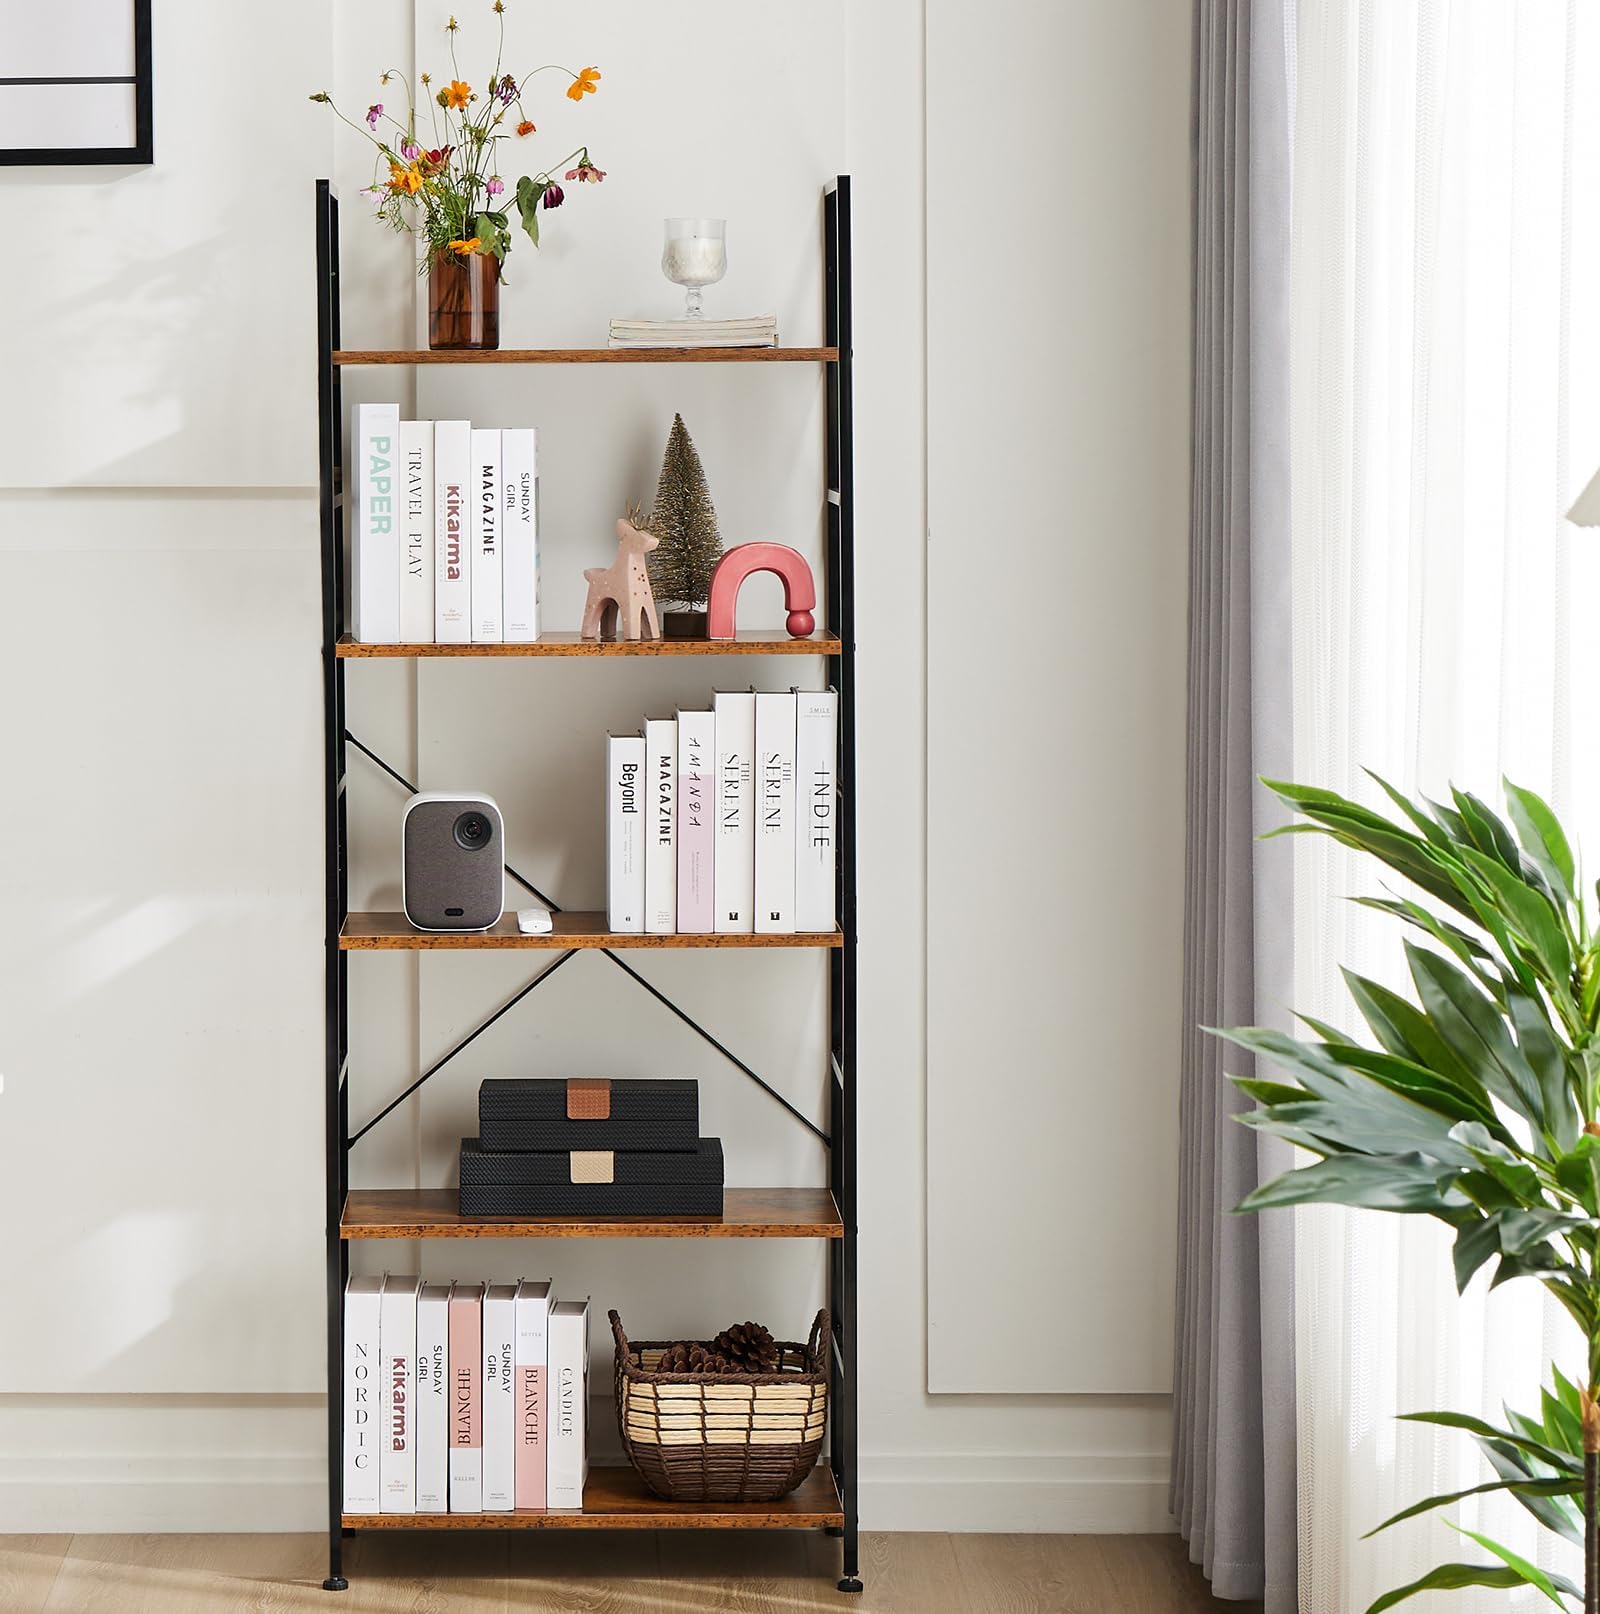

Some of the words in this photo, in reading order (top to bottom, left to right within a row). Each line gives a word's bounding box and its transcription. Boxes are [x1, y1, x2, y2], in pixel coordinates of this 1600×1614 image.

[369, 436, 391, 534] PAPER
[409, 447, 422, 520] TRAVEL
[482, 465, 495, 556] MAGAZINE
[506, 484, 516, 512] GIRL
[520, 472, 530, 523] SUNDAY
[409, 533, 422, 578] PLAY
[618, 763, 638, 814] Beyond
[659, 755, 672, 846] MAGAZINE
[688, 737, 701, 827] AMANDA
[725, 753, 740, 835] SERENE
[741, 760, 751, 784] THE
[766, 752, 782, 834] SERENE
[782, 760, 792, 784] THE
[813, 771, 830, 848] INDIE
[418, 1356, 428, 1384] GIRL
[433, 1344, 443, 1396] SUNDAY
[487, 1354, 497, 1382] GIRL
[501, 1343, 511, 1394] SUNDAY
[561, 1367, 573, 1437] CANDICE
[457, 1367, 471, 1445] BLANCHE
[524, 1368, 538, 1446] BLANCHE
